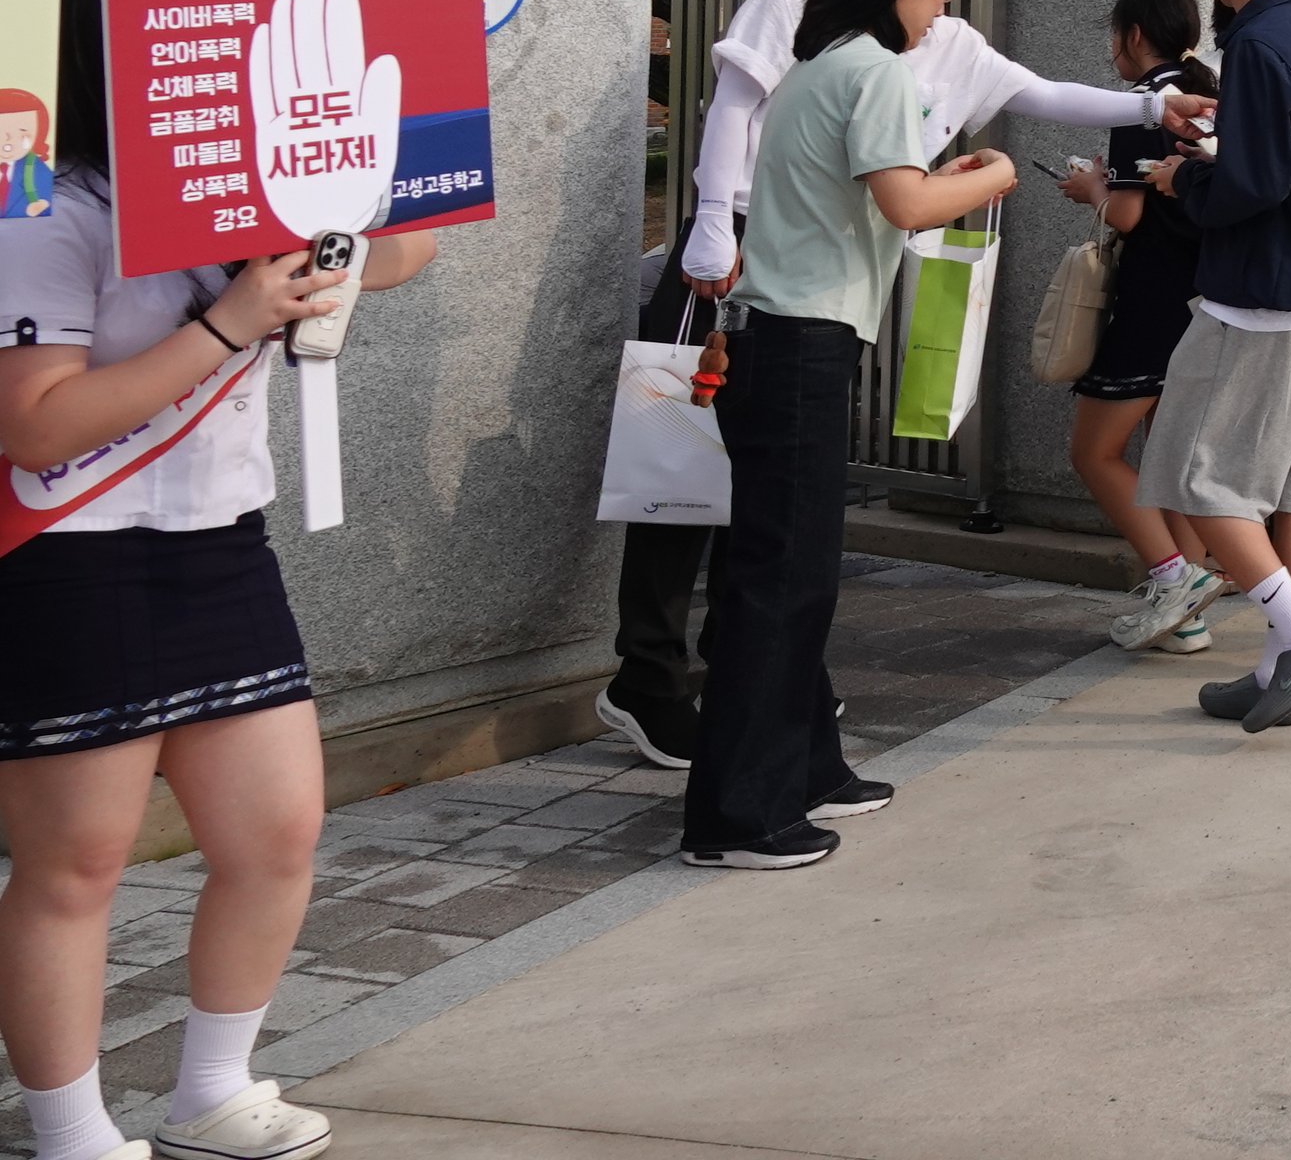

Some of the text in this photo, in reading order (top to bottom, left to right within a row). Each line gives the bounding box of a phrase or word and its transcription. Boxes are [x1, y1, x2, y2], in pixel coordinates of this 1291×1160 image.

[144, 3, 255, 30] 사이버폭력
[151, 38, 241, 66] 언어폭력
[148, 72, 238, 102] 신체폭력
[149, 105, 240, 136] 금품갈취
[289, 91, 353, 130] 모두
[173, 139, 241, 168] 따돌림
[267, 134, 376, 180] 사라져!
[182, 172, 249, 202] 성폭력
[392, 170, 484, 199] 고성고등학교
[213, 205, 259, 232] 강요
